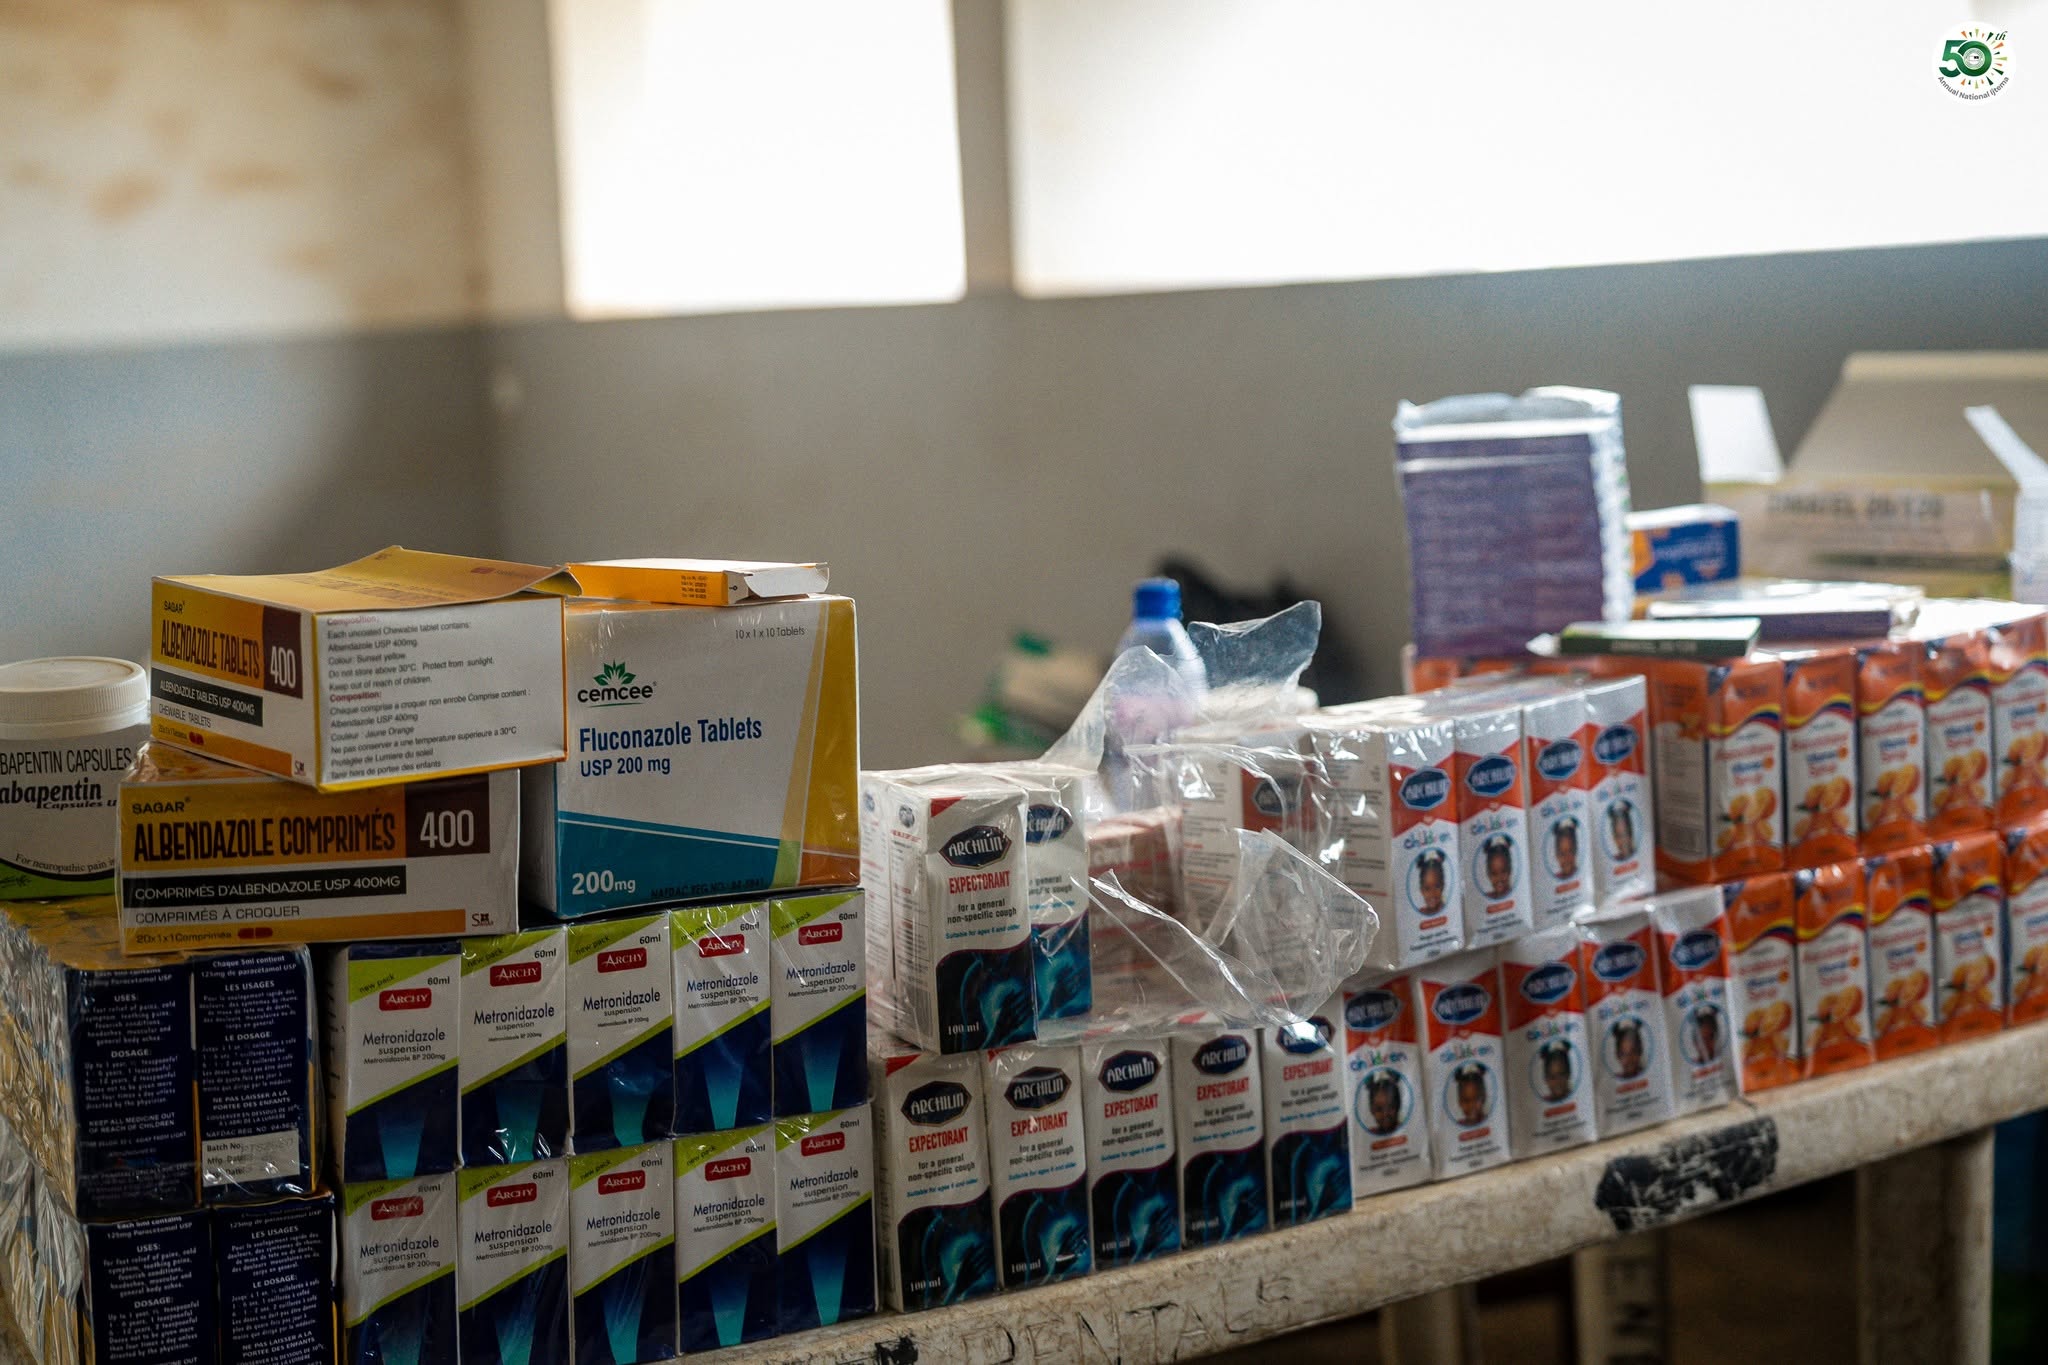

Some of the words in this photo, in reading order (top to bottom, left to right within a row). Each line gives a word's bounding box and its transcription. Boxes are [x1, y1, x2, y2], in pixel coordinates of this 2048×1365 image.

[164, 600, 182, 614] SAGAR
[735, 629, 744, 640] 10
[752, 628, 756, 639] 1
[766, 628, 775, 638] 10
[776, 626, 805, 637] Tablets
[374, 640, 391, 648] USP
[393, 638, 418, 648] 400mg
[161, 619, 218, 669] ALBENDAZOLE
[220, 632, 260, 679] TABLETS
[270, 645, 296, 688] 400
[422, 662, 446, 670] Protect
[448, 660, 464, 668] from
[160, 680, 195, 700] ALBENDAZOLE
[194, 689, 218, 706] TABLETS
[218, 695, 232, 708] USP
[232, 698, 256, 716] 400MG
[578, 684, 654, 702] cemcee
[158, 704, 186, 721] CHEWABLE
[188, 711, 211, 728] TABLETS
[500, 726, 516, 736] 30°C
[580, 721, 692, 752] Fluconazole
[697, 717, 762, 743] Tablets
[66, 748, 132, 772] CAPSULES
[580, 758, 612, 777] USP
[616, 756, 642, 774] 200
[648, 758, 670, 776] mg
[42, 800, 102, 811] Capsules
[132, 801, 184, 814] SAGAR
[134, 818, 274, 862] ALBENDAZOLE
[280, 808, 396, 856] COMPRIMÉS
[420, 810, 474, 848] 400
[949, 836, 1004, 858] ARCHILIN
[16, 853, 30, 864] For
[32, 860, 86, 872] neuropathic
[88, 862, 104, 872] pain
[135, 885, 215, 900] COMPRIMÉS
[218, 880, 322, 897] D'ALBENDAZOLE
[325, 878, 350, 890] USP
[354, 876, 400, 889] 400MG
[572, 870, 636, 896] 200mg
[949, 870, 1010, 894] EXPECTORANT
[958, 903, 968, 912] for
[976, 898, 1006, 912] general
[136, 909, 218, 924] COMPRIMÉS
[222, 908, 232, 920] À
[236, 906, 300, 920] CROQUER
[839, 912, 858, 920] 60ml
[947, 910, 994, 924] non-specific
[996, 906, 1017, 918] cough
[640, 934, 660, 944] 60ml
[802, 929, 840, 938] ARCHY
[534, 948, 556, 958] 60ml
[212, 960, 239, 968] Chaque
[256, 955, 284, 964] contient
[284, 963, 296, 971] USP
[602, 954, 643, 968] ARCHY
[496, 968, 538, 981] ARCHY
[786, 960, 856, 980] Metronidazole
[224, 984, 240, 992] LES
[242, 980, 275, 990] USAGES
[428, 976, 450, 986] 60ml
[686, 972, 758, 992] Metronidazole
[387, 994, 428, 1004] ARCHY
[583, 987, 660, 1012] Metronidazole
[700, 988, 746, 1000] suspension
[604, 1006, 642, 1016] suspension
[688, 1000, 729, 1009] Metronidazole
[474, 1002, 554, 1024] Metronidazole
[496, 1021, 534, 1032] suspension
[948, 1022, 964, 1036] 100
[966, 1020, 980, 1032] ml
[224, 1034, 234, 1042] LE
[362, 1028, 446, 1046] Metronidazole
[378, 1044, 431, 1056] suspension
[1106, 1060, 1154, 1083] ARCHILIN
[1014, 1078, 1064, 1101] ARCHILIN
[910, 1092, 964, 1115] ARCHILIN
[1104, 1094, 1158, 1118] EXPECTORANT
[840, 1120, 859, 1128] 60ml
[806, 1138, 842, 1150] ARCHY
[909, 1126, 968, 1153] EXPECTORANT
[207, 1143, 228, 1152] Batch
[746, 1144, 766, 1153] 60ml
[642, 1158, 662, 1167] 60ml
[710, 1162, 748, 1174] ARCHY
[918, 1162, 928, 1170] for
[938, 1154, 964, 1167] general
[532, 1170, 554, 1180] 60ml
[790, 1167, 858, 1190] Metronidazole
[908, 1167, 952, 1182] non-specific
[955, 1162, 976, 1172] cough
[603, 1176, 642, 1186] ARCHY
[492, 1188, 534, 1200] ARCHY
[804, 1183, 848, 1198] suspension
[694, 1194, 764, 1216] Metronidazole
[586, 1208, 660, 1230] Metronidazole
[705, 1208, 751, 1222] suspension
[252, 1230, 266, 1240] LES
[268, 1225, 299, 1236] USAGES
[474, 1220, 552, 1244] Metronidazole
[600, 1223, 648, 1237] suspension
[489, 1236, 539, 1250] suspension
[1011, 1260, 1026, 1272] 100
[1029, 1258, 1040, 1271] ml
[910, 1280, 926, 1292] 100
[928, 1276, 941, 1288] ml
